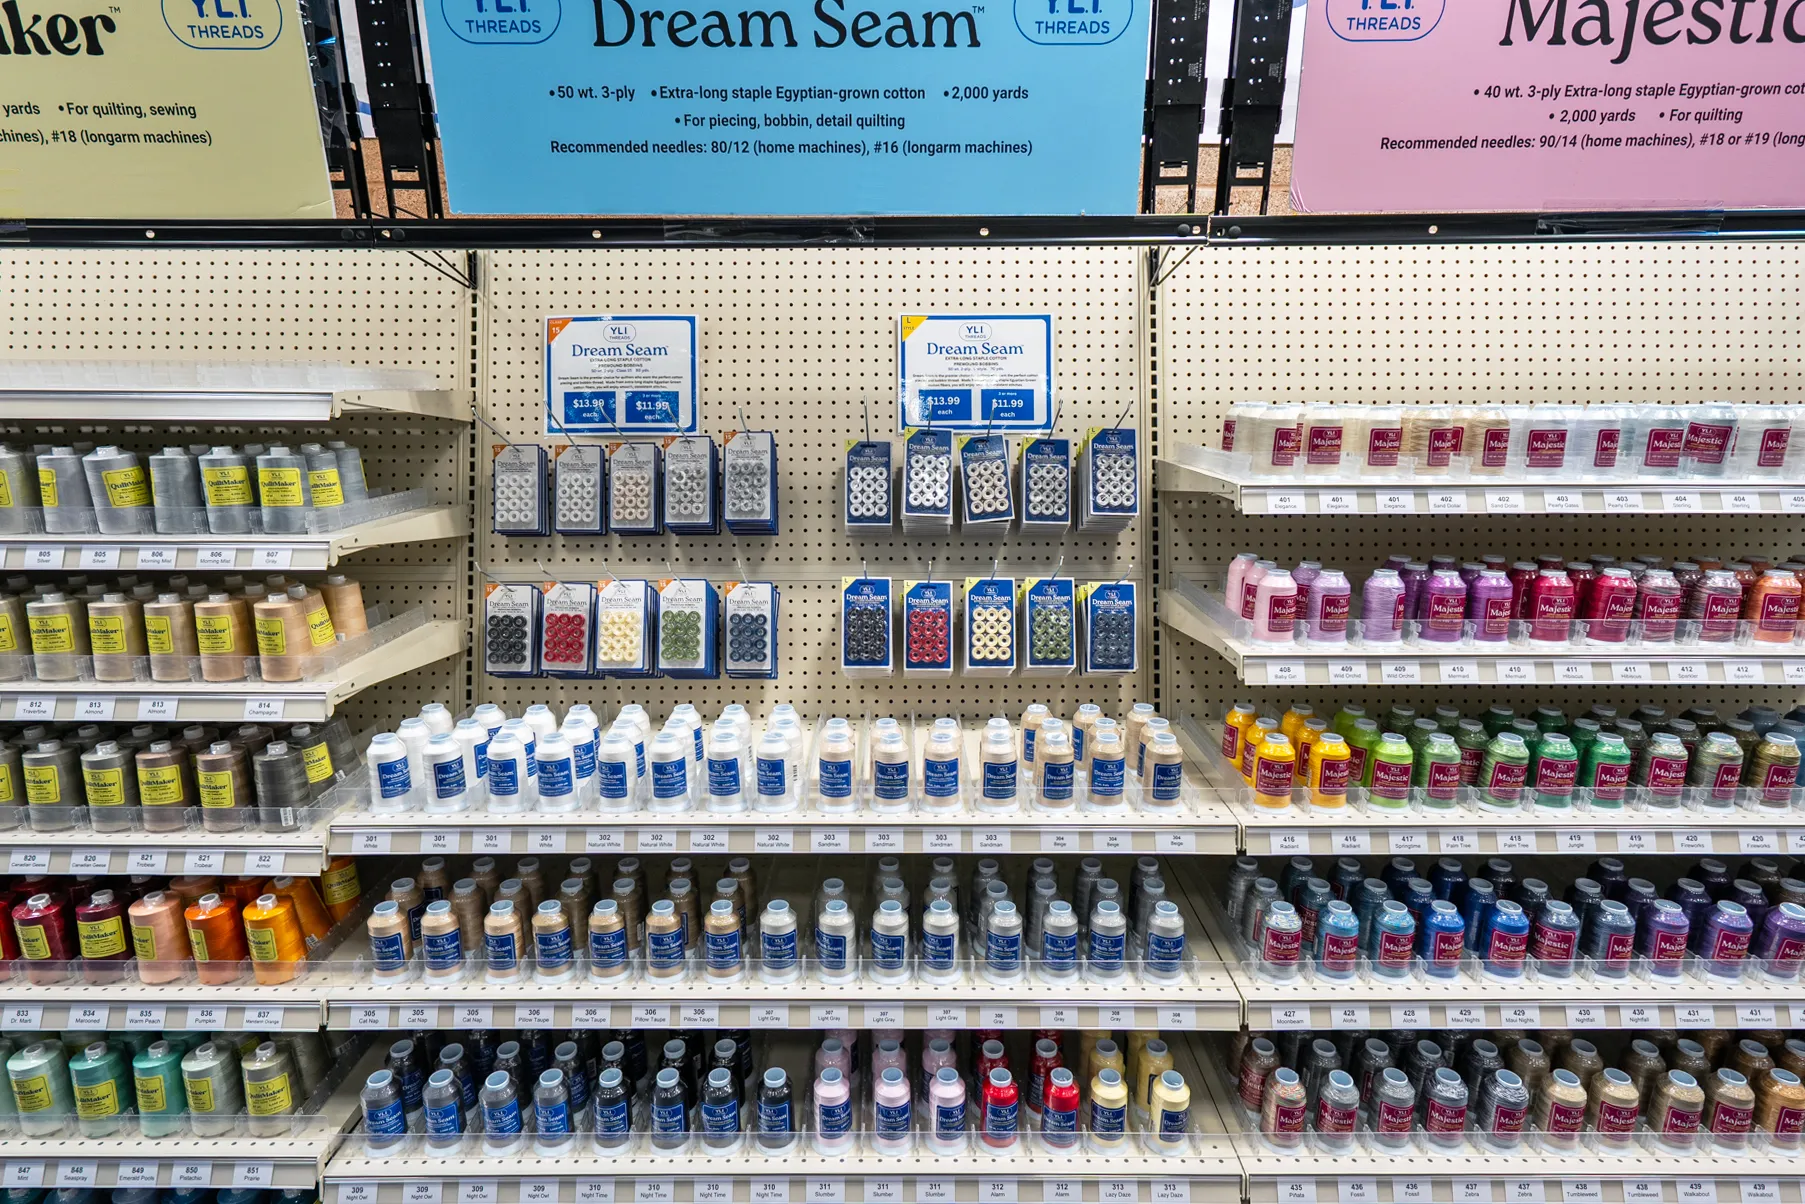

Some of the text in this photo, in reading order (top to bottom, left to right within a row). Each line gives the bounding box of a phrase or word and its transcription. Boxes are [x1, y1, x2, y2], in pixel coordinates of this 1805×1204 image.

[465, 20, 541, 33] THREADS
[593, 0, 798, 47] Dream
[1035, 21, 1110, 34] THREADS
[1347, 17, 1421, 31] THREADS
[187, 25, 264, 39] THREADS
[557, 85, 635, 102] 50 wt. 3-ply
[660, 86, 925, 102] Extra-long staple Egyptian-grown cotton
[952, 86, 1028, 102] 2,000 yards
[1484, 86, 1500, 98] 40
[1505, 86, 1522, 97] wt.
[1528, 85, 1561, 100] 3-ply
[1565, 84, 1632, 99] Extra-long
[1636, 83, 1675, 99] staple
[1679, 83, 1781, 99] Egyptian-grown
[3, 102, 41, 118] yards
[67, 102, 196, 118] For quilting, sewing
[1560, 109, 1635, 125] 2,000 yards
[1670, 108, 1743, 124] For quilting
[684, 114, 904, 129] For piecing, bobbin, detail quilting
[52, 130, 77, 143] #18
[81, 130, 140, 146] (longarm
[144, 131, 211, 146] machines)
[1381, 135, 1476, 149] Recommended
[1481, 135, 1535, 148] needles:
[1540, 135, 1576, 148] 90/14
[1581, 134, 1621, 150] (home
[1625, 133, 1695, 149] machines),
[1700, 133, 1724, 145] #18
[1728, 136, 1741, 145] or
[1745, 132, 1769, 144] #19
[551, 140, 1032, 156] Recommended needles: 80/12 (home machines), #16 (longarm machines)
[572, 344, 622, 356] Dream
[927, 343, 978, 354] Dream
[1688, 434, 1723, 444] Majestic
[820, 1182, 830, 1190] 311
